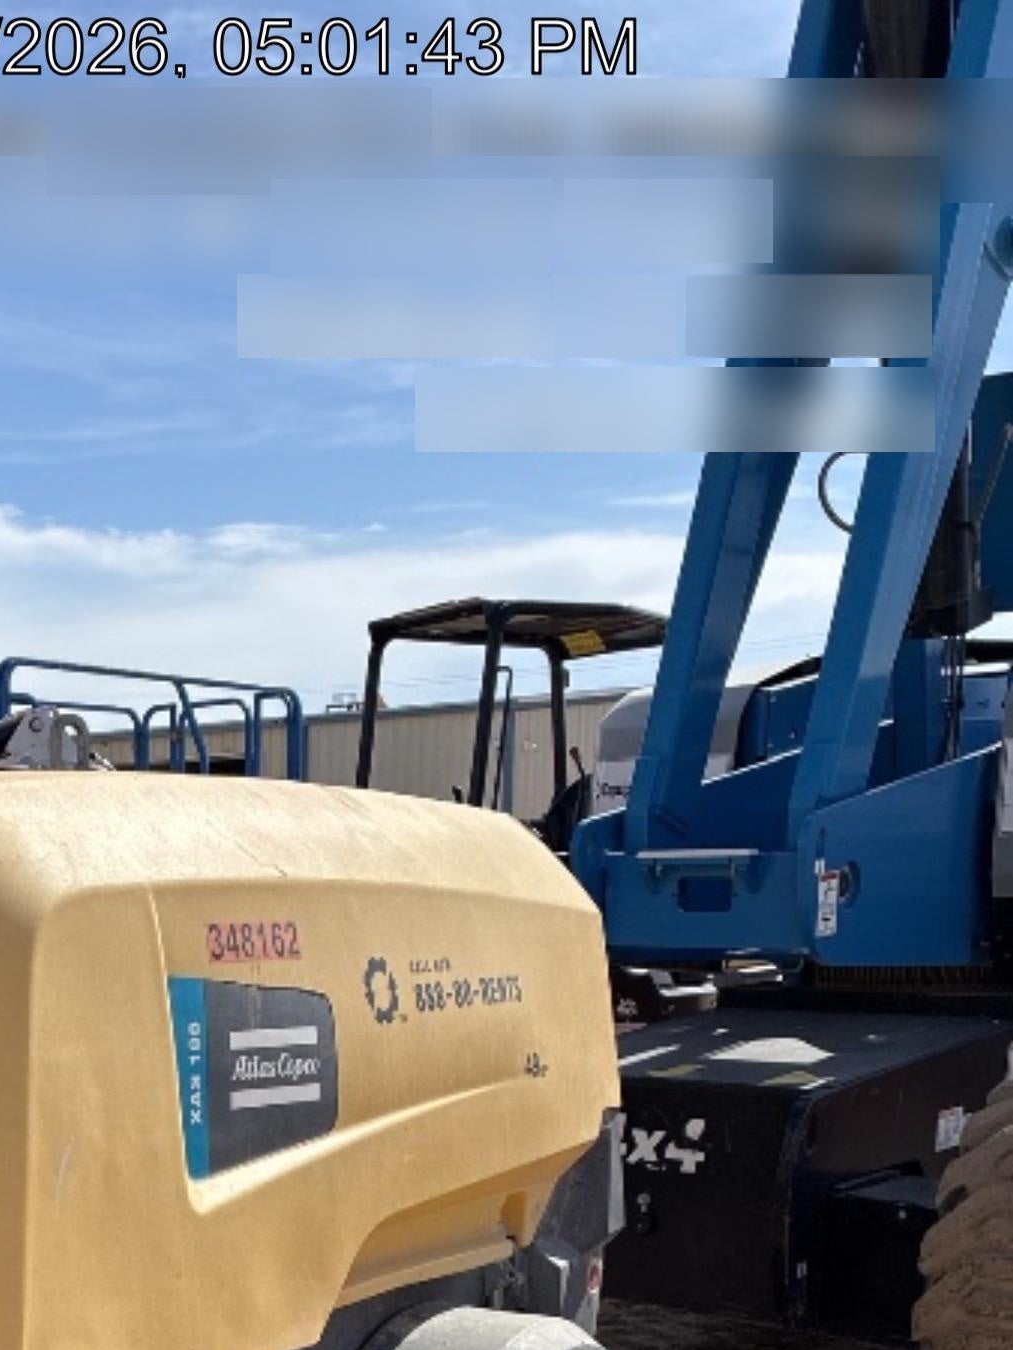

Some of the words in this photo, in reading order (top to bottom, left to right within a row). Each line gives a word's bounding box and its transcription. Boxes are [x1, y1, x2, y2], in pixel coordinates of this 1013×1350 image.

[208, 923, 300, 960] 348162
[231, 1055, 276, 1081] Atlas
[277, 1053, 320, 1081] Copco
[620, 1118, 705, 1174] x4
